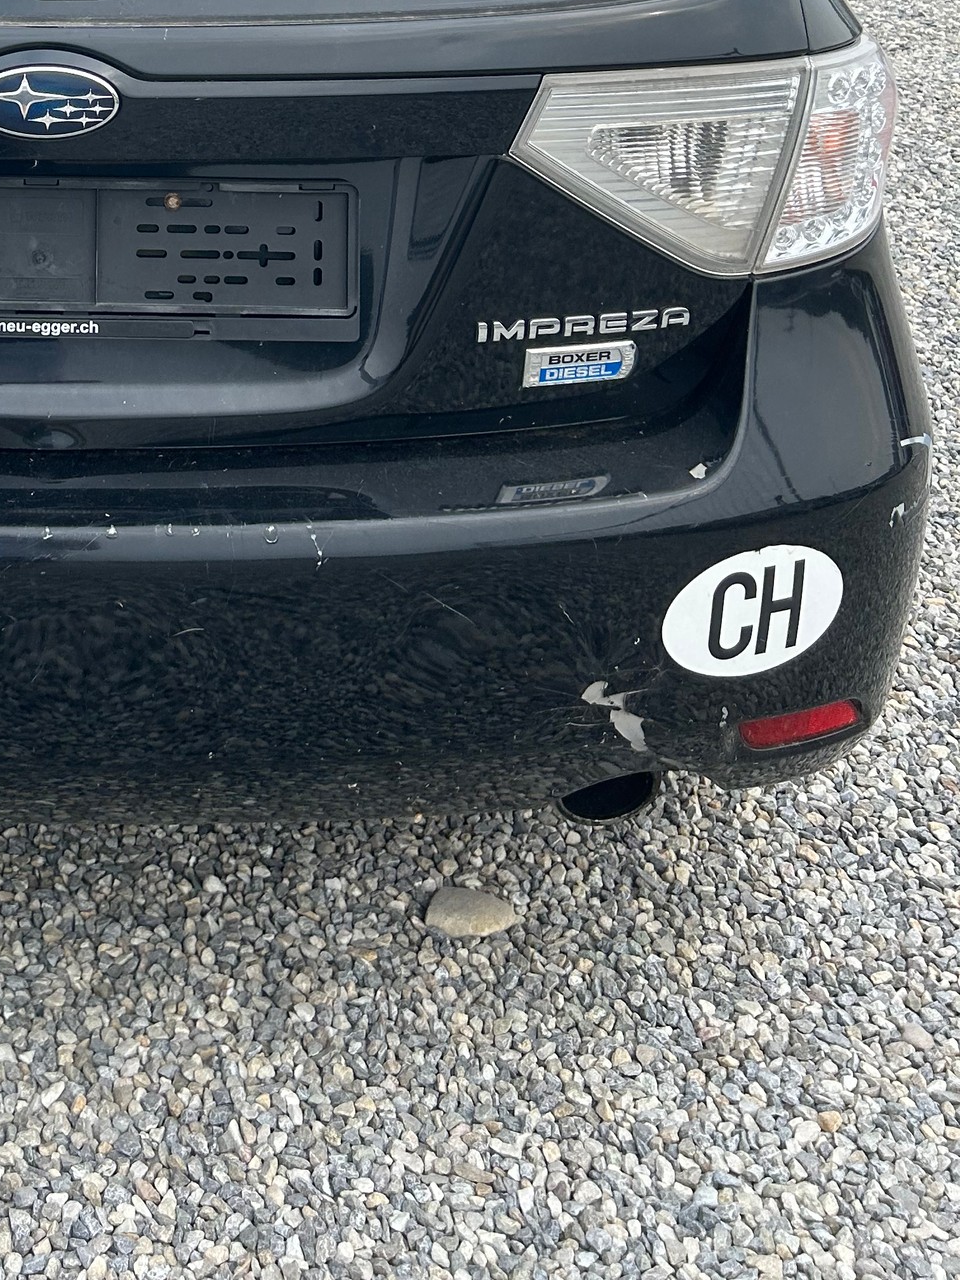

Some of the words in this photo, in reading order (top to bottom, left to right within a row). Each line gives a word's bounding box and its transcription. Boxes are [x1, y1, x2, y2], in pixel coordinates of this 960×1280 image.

[477, 306, 691, 343] IMPREZA
[548, 350, 612, 366] BOXER
[545, 364, 613, 381] DIESEL
[707, 558, 806, 660] CH
